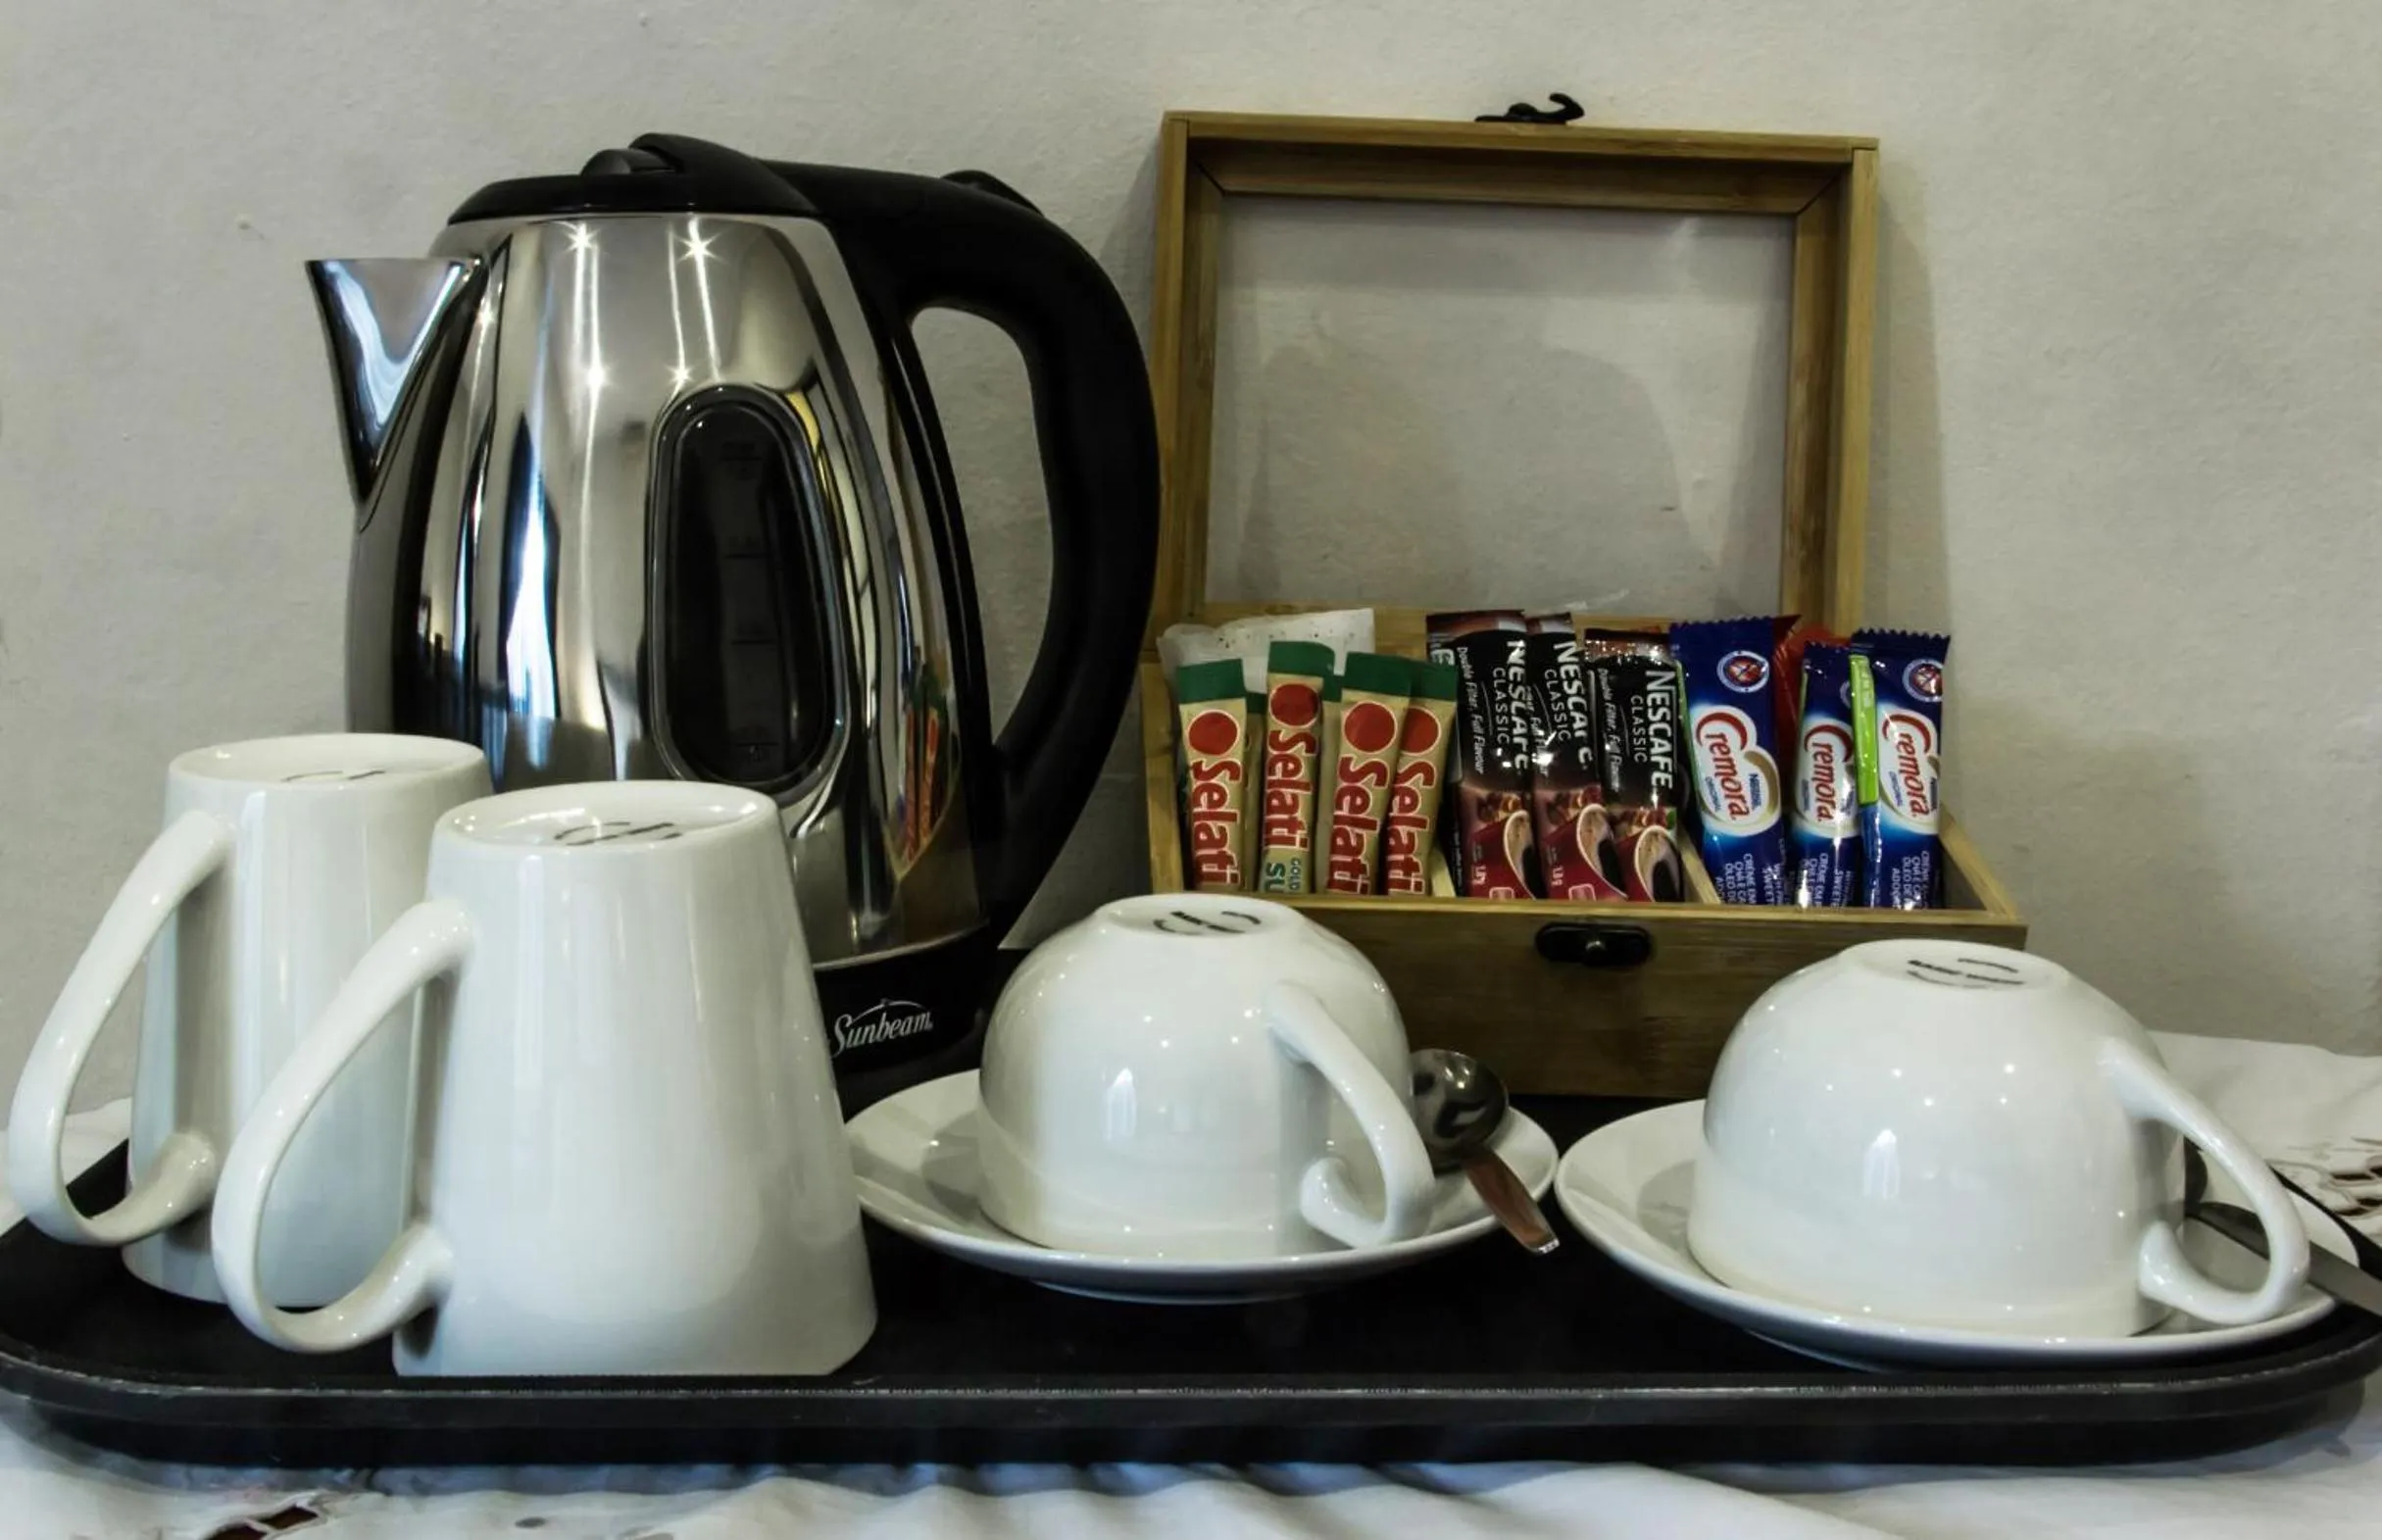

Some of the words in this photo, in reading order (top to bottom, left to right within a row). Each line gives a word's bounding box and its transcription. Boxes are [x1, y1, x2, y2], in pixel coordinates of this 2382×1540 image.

[1470, 713, 1483, 735] Full
[1493, 668, 1511, 745] CLASSIC
[1544, 669, 1571, 741] CLASSIC
[1630, 695, 1648, 763] CLASSIC
[1265, 730, 1316, 851] Selati
[1472, 735, 1486, 775] Flavour
[1190, 760, 1243, 884] Selati
[1326, 754, 1391, 895] Selati
[1387, 761, 1436, 894] Selati
[831, 1012, 932, 1058] Sunbeam
